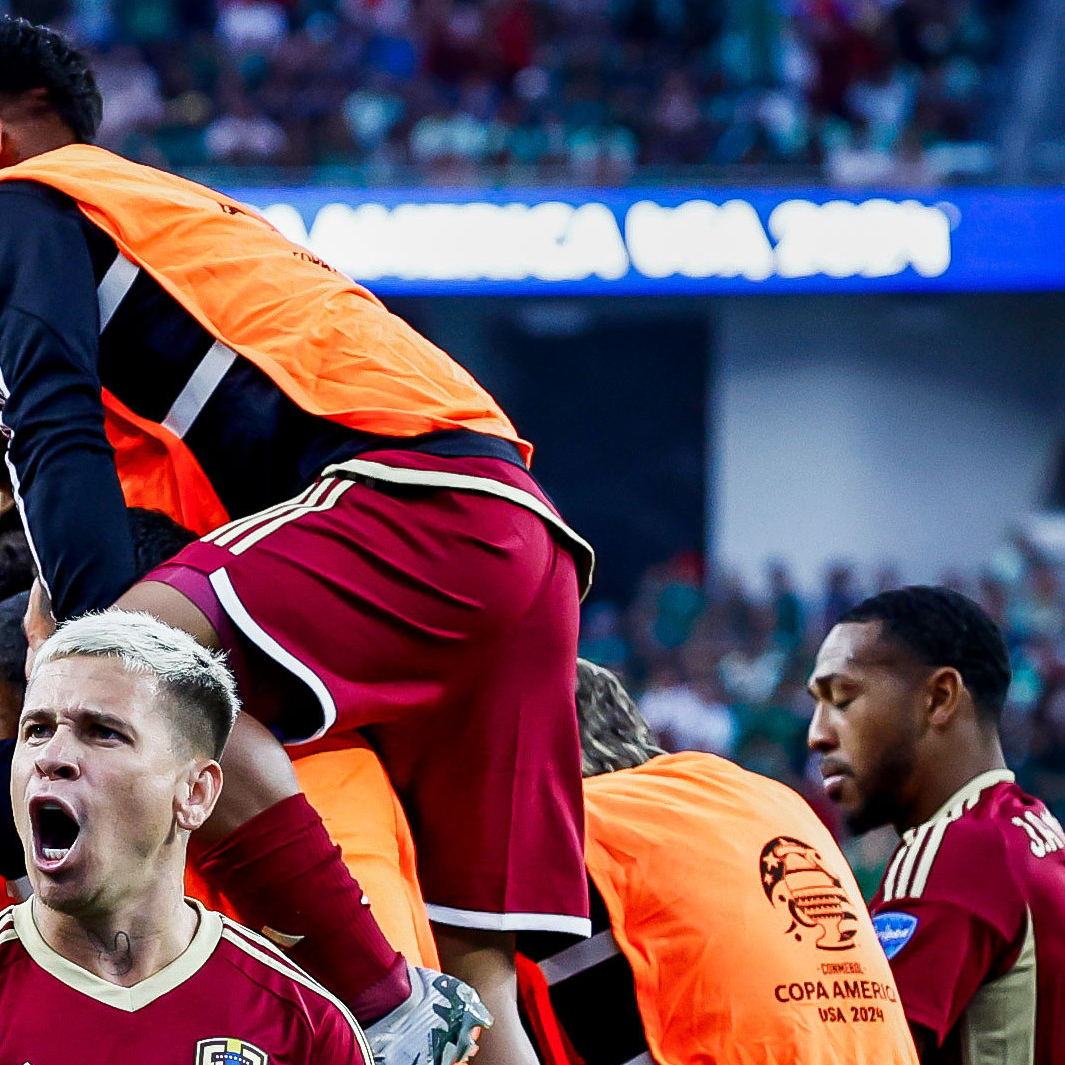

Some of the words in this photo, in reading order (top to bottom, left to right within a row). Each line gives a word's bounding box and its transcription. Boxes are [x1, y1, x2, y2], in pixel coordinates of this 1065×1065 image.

[775, 980, 830, 1003] COPA
[817, 1006, 847, 1023] USA
[850, 1005, 885, 1022] 2024
